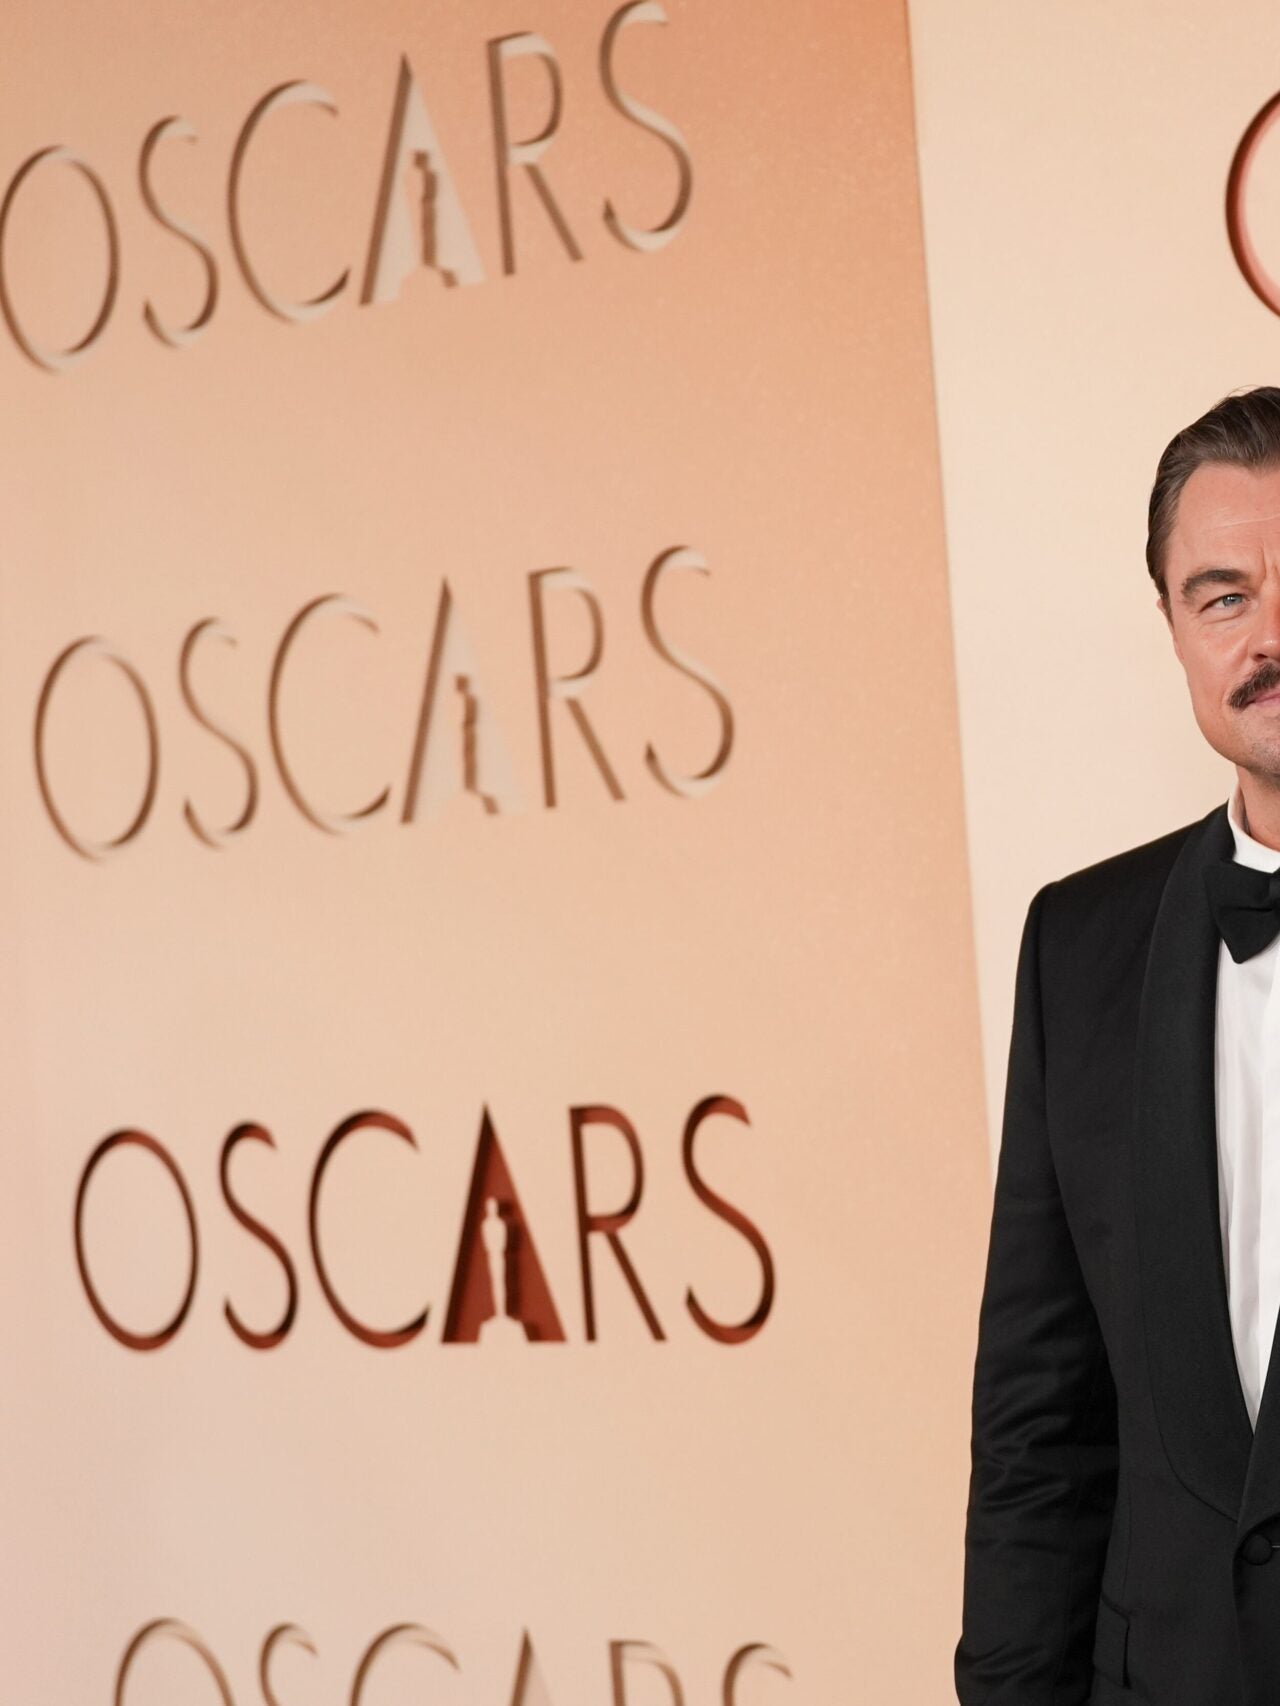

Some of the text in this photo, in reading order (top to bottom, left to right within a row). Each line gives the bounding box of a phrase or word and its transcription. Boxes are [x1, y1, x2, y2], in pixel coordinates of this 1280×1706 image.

[0, 0, 693, 374] OSCARS
[33, 545, 735, 863] OSCARS
[73, 1093, 777, 1353] OSCARS
